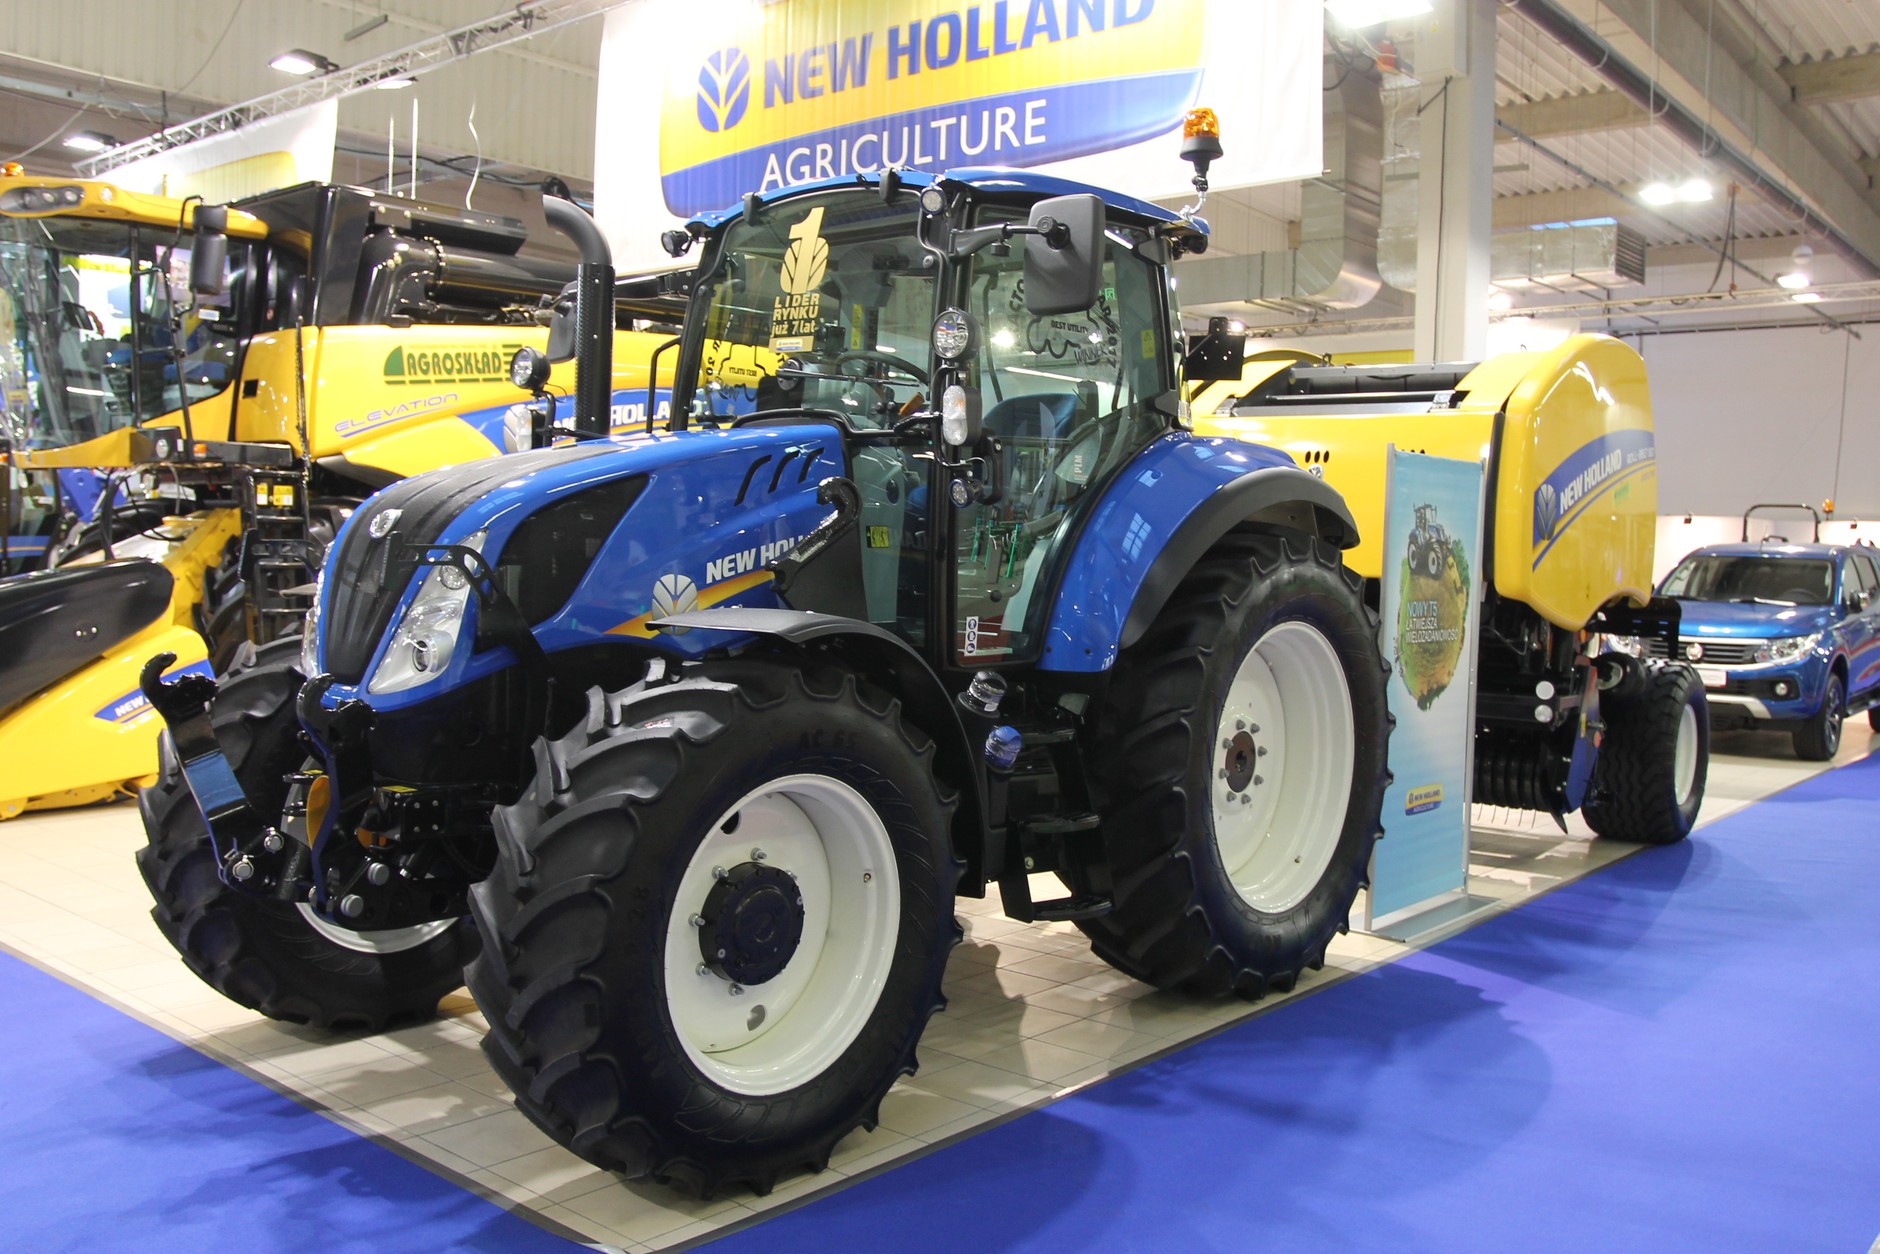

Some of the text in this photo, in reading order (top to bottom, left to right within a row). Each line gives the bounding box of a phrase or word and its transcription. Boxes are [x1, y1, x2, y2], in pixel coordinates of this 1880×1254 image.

[764, 32, 873, 108] NEW
[760, 98, 1047, 193] AGRICULTURE
[774, 293, 820, 309] LIDER
[772, 305, 819, 321] RYNKU
[770, 320, 816, 338] już 7 lat
[1050, 320, 1089, 334] BEST UTILITY
[334, 393, 458, 432] ELEVATION
[1074, 454, 1083, 474] PLM
[1559, 473, 1584, 515] NEW
[1583, 448, 1622, 493] HOLLAND
[706, 547, 757, 585] NEW
[1407, 600, 1438, 617] NOWY T5
[114, 695, 144, 718] NEW
